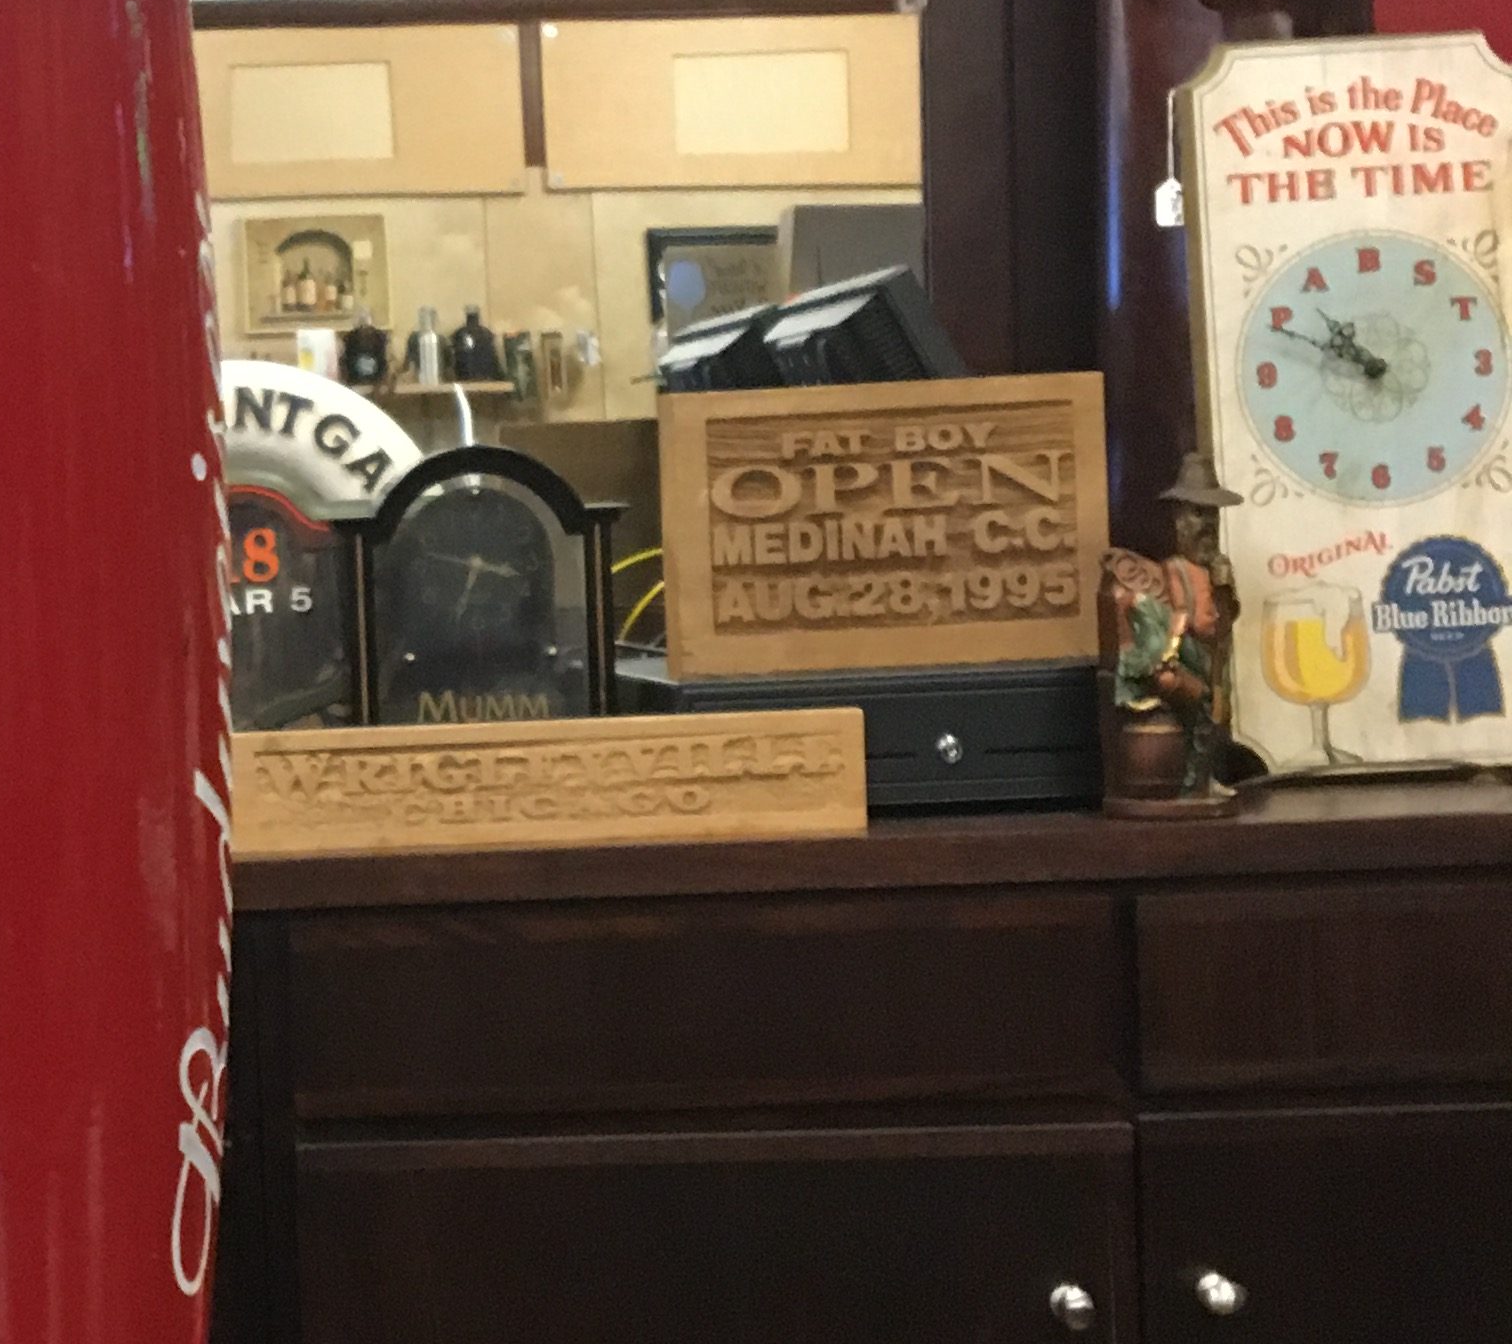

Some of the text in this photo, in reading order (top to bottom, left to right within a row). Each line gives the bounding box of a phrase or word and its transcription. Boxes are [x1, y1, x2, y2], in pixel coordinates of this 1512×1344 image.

[1212, 74, 1499, 159] This is the Place
[1281, 120, 1395, 158] NOW
[1226, 159, 1494, 205] THE TIME
[1255, 360, 1279, 390] 9
[1473, 348, 1494, 377] 3
[1273, 414, 1296, 443] 8
[1460, 403, 1486, 432] 4
[781, 422, 998, 459] FAT BOY
[1318, 449, 1340, 481] 7
[1426, 444, 1447, 474] 5
[710, 449, 1077, 519] OPEN
[1370, 462, 1392, 490] 6
[711, 513, 949, 567] MEDINAH
[1266, 529, 1392, 579] ORIGINAL
[1401, 554, 1484, 595] Pabst
[290, 586, 313, 613] 5
[1374, 604, 1429, 631] Blue
